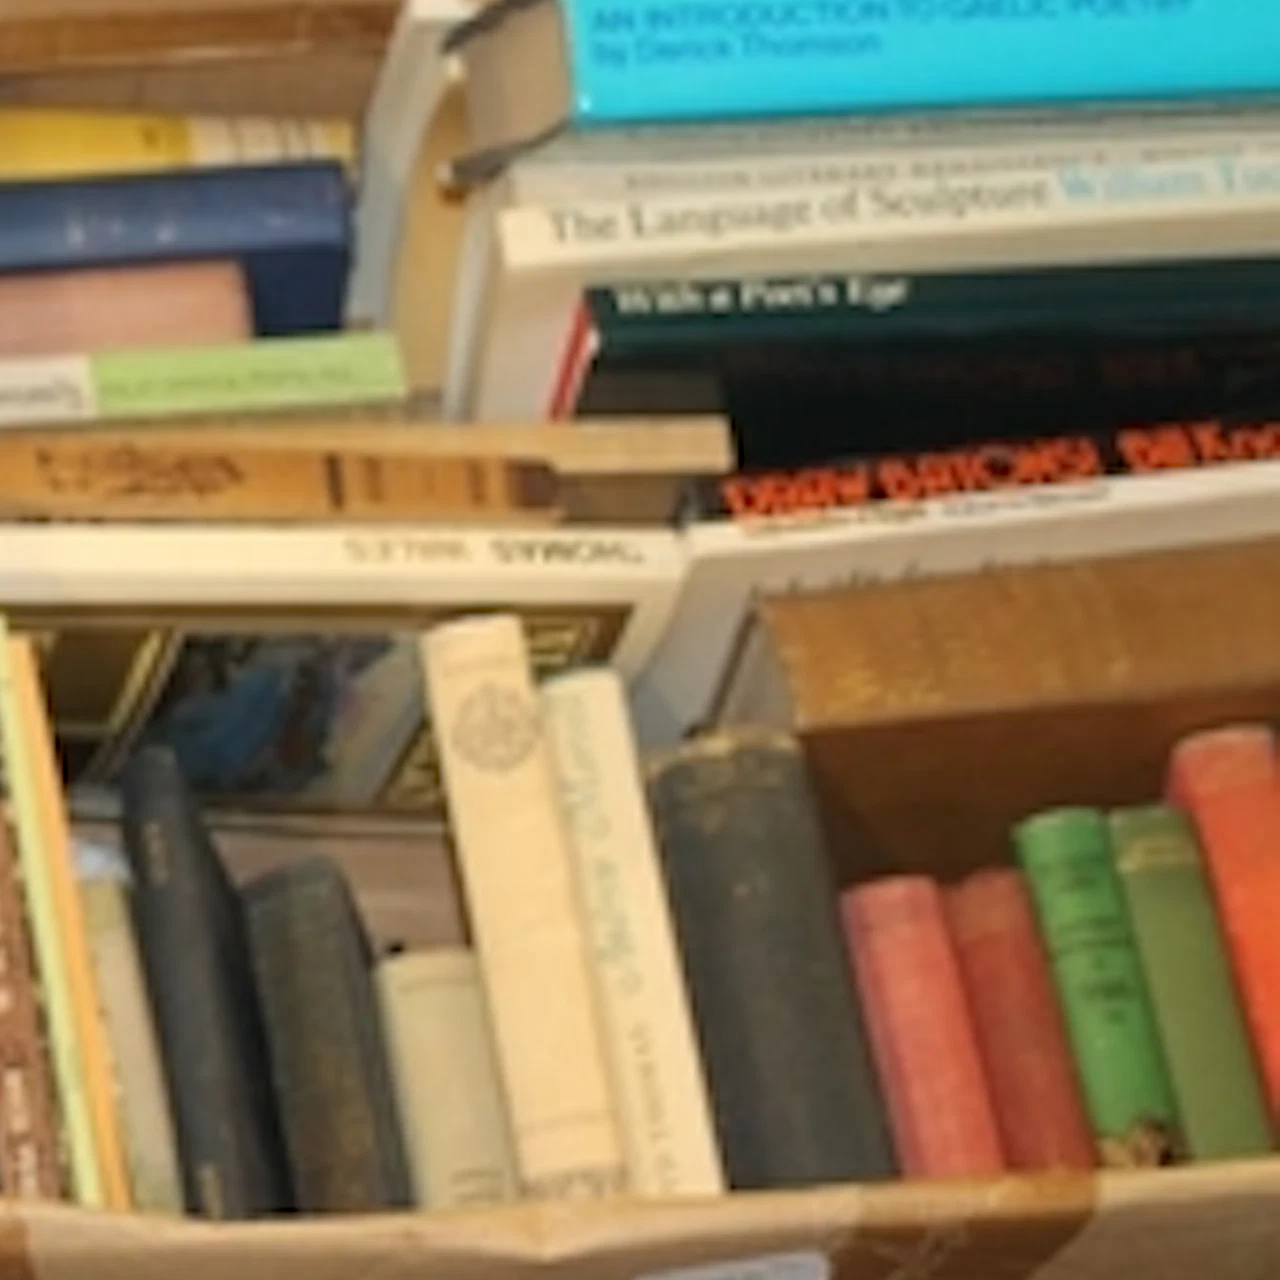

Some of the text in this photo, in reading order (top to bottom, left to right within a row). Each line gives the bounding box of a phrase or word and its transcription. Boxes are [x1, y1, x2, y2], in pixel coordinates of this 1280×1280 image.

[592, 6, 635, 35] AN
[591, 29, 882, 70] by Derick Thomson
[552, 210, 618, 246] The
[630, 194, 812, 242] Language
[819, 188, 860, 222] of
[870, 176, 1051, 222] Sculpture
